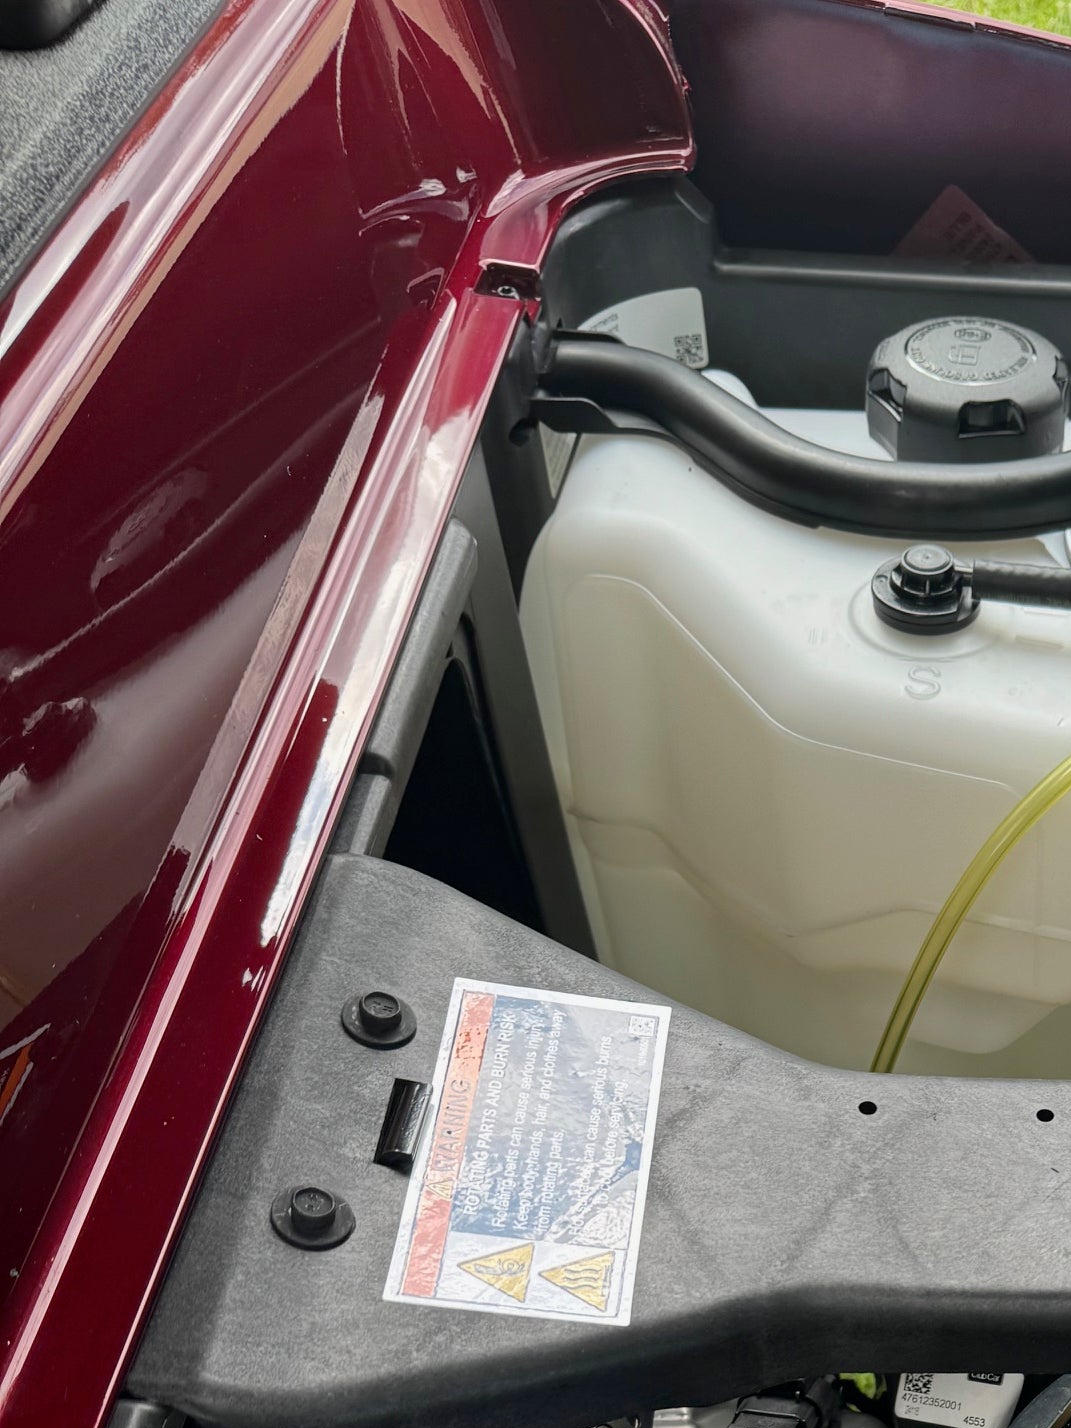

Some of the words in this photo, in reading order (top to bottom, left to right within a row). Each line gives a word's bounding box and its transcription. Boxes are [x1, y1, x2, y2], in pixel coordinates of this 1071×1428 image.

[500, 1010, 516, 1041] RISK
[550, 1009, 567, 1038] away
[492, 1049, 510, 1078] BURN
[521, 1052, 536, 1090] serious
[544, 1036, 558, 1077] clothes
[486, 1080, 502, 1106] AND
[540, 1080, 552, 1100] and
[592, 1068, 606, 1106] serious
[514, 1091, 529, 1124] cause
[532, 1102, 550, 1124] hair,
[609, 1080, 628, 1129] servicing.
[431, 1078, 473, 1171] WARNING
[478, 1108, 497, 1149] PARTS
[510, 1126, 522, 1146] can
[587, 1106, 601, 1140] cause
[504, 1149, 519, 1176] parts
[583, 1142, 596, 1164] can
[602, 1131, 618, 1165] before
[464, 1150, 489, 1215] ROTATING
[535, 1204, 550, 1236] from
[544, 1162, 562, 1203] rotating
[491, 1176, 516, 1229] Rotating
[513, 1194, 532, 1230] Keep
[902, 1393, 962, 1410] 47612352001
[963, 1416, 986, 1427] 4553
